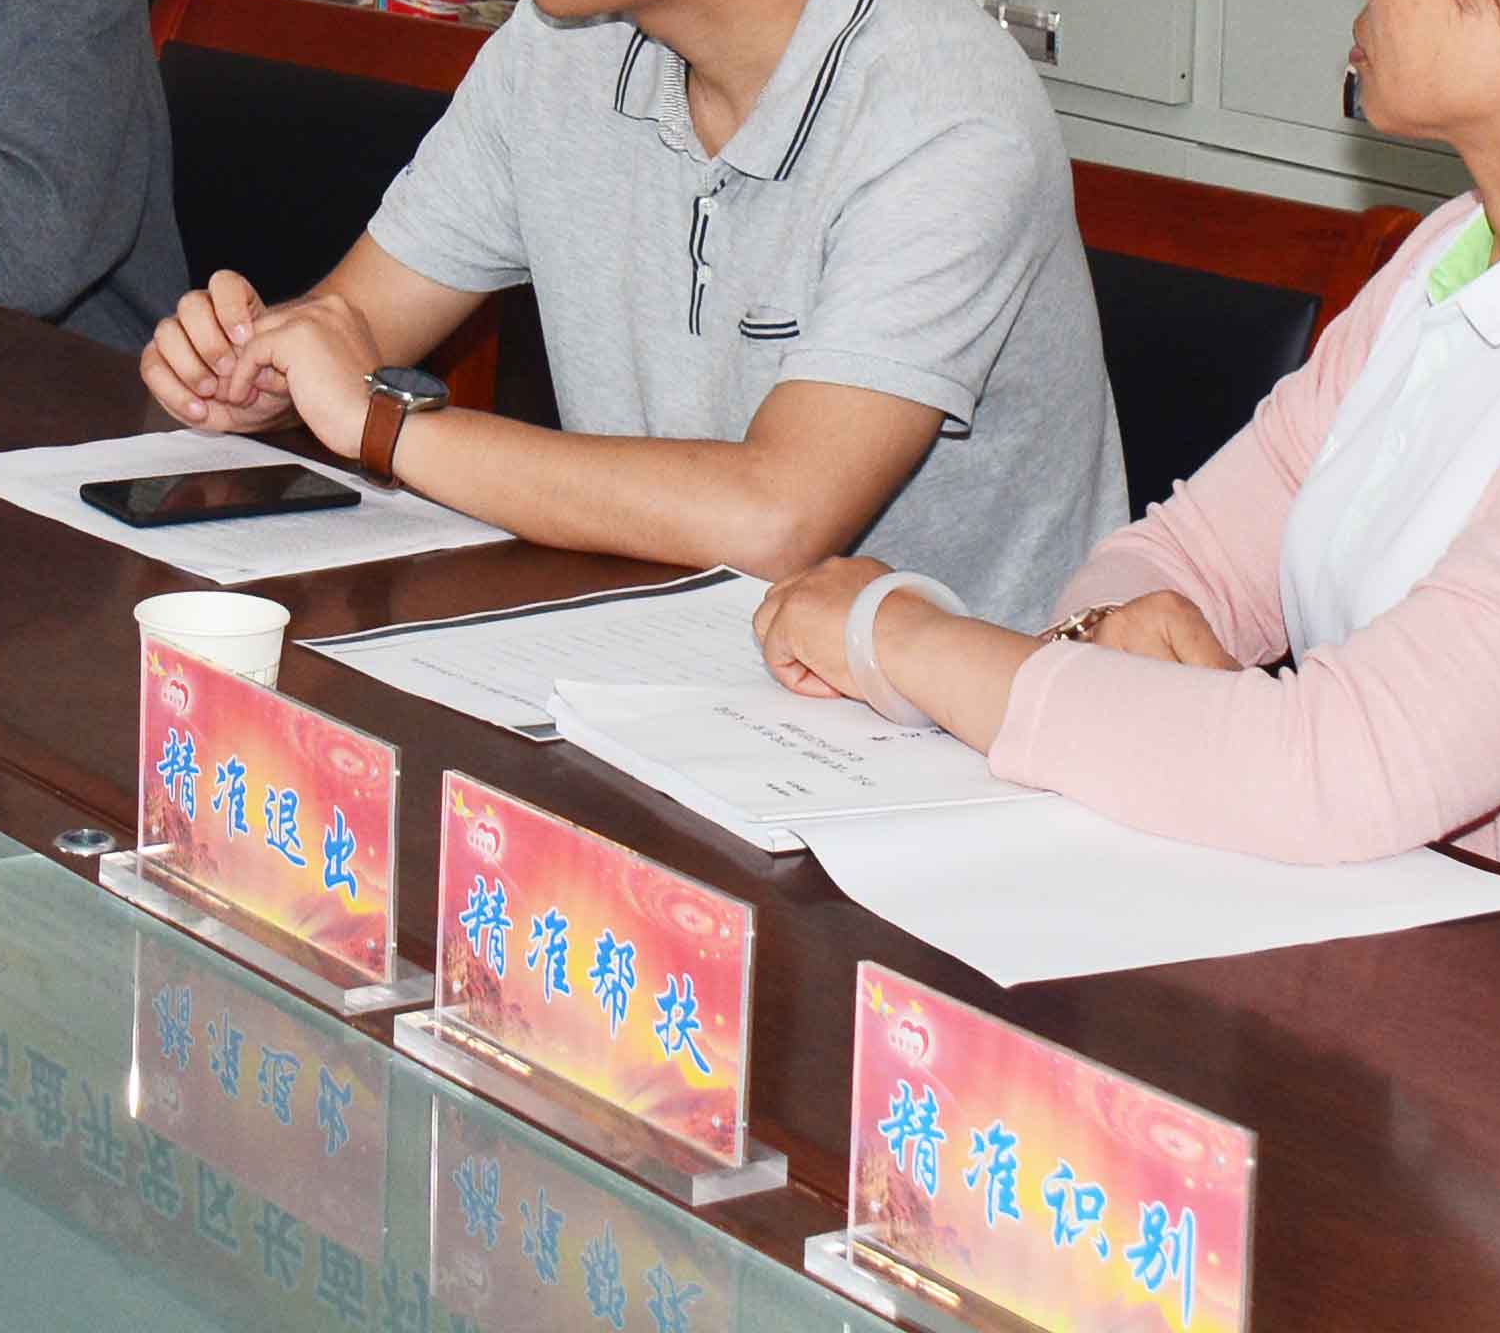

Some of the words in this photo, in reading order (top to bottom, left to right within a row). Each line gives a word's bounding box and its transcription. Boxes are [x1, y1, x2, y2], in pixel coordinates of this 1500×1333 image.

[158, 729, 357, 900] 精准退出
[461, 876, 712, 1075] 精准帮扶
[878, 1078, 1197, 1328] 精准识别
